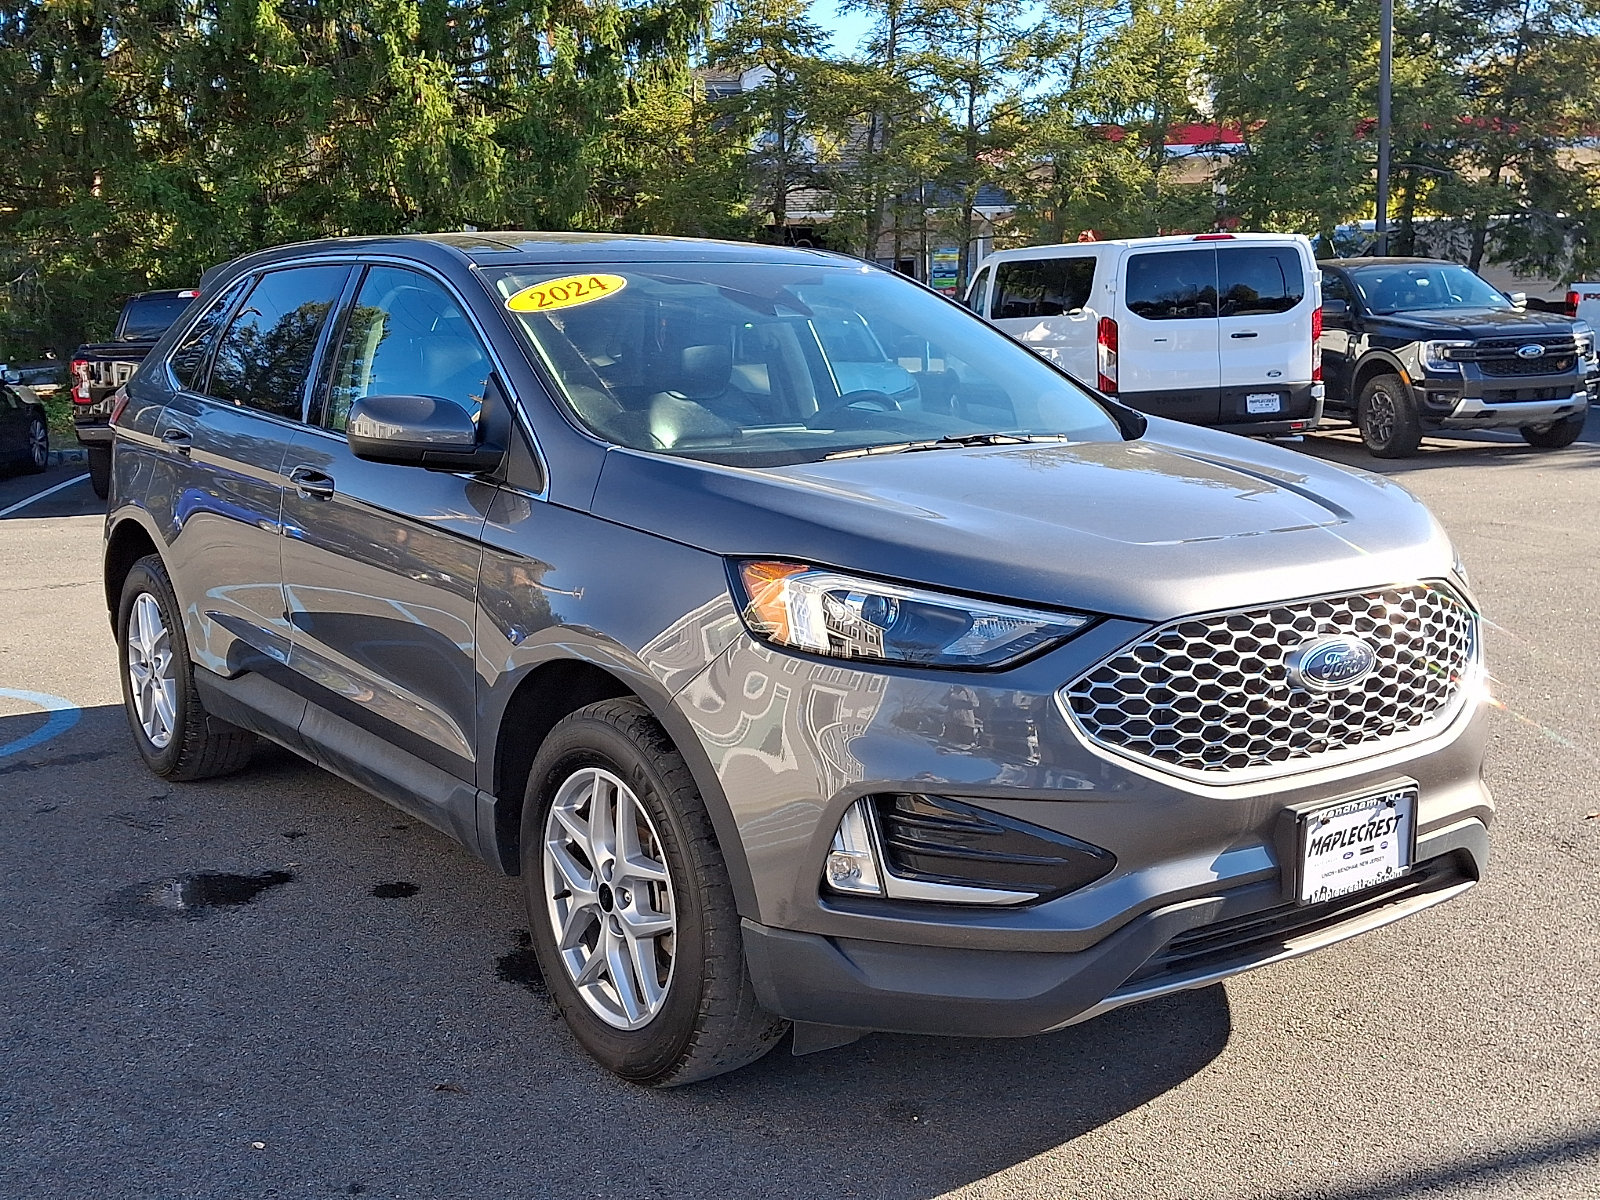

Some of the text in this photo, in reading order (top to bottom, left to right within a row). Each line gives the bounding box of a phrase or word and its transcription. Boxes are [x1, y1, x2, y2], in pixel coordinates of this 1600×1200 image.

[529, 277, 608, 308] 2024
[1321, 648, 1366, 679] Ford
[1308, 814, 1403, 858] MAPLECREST
